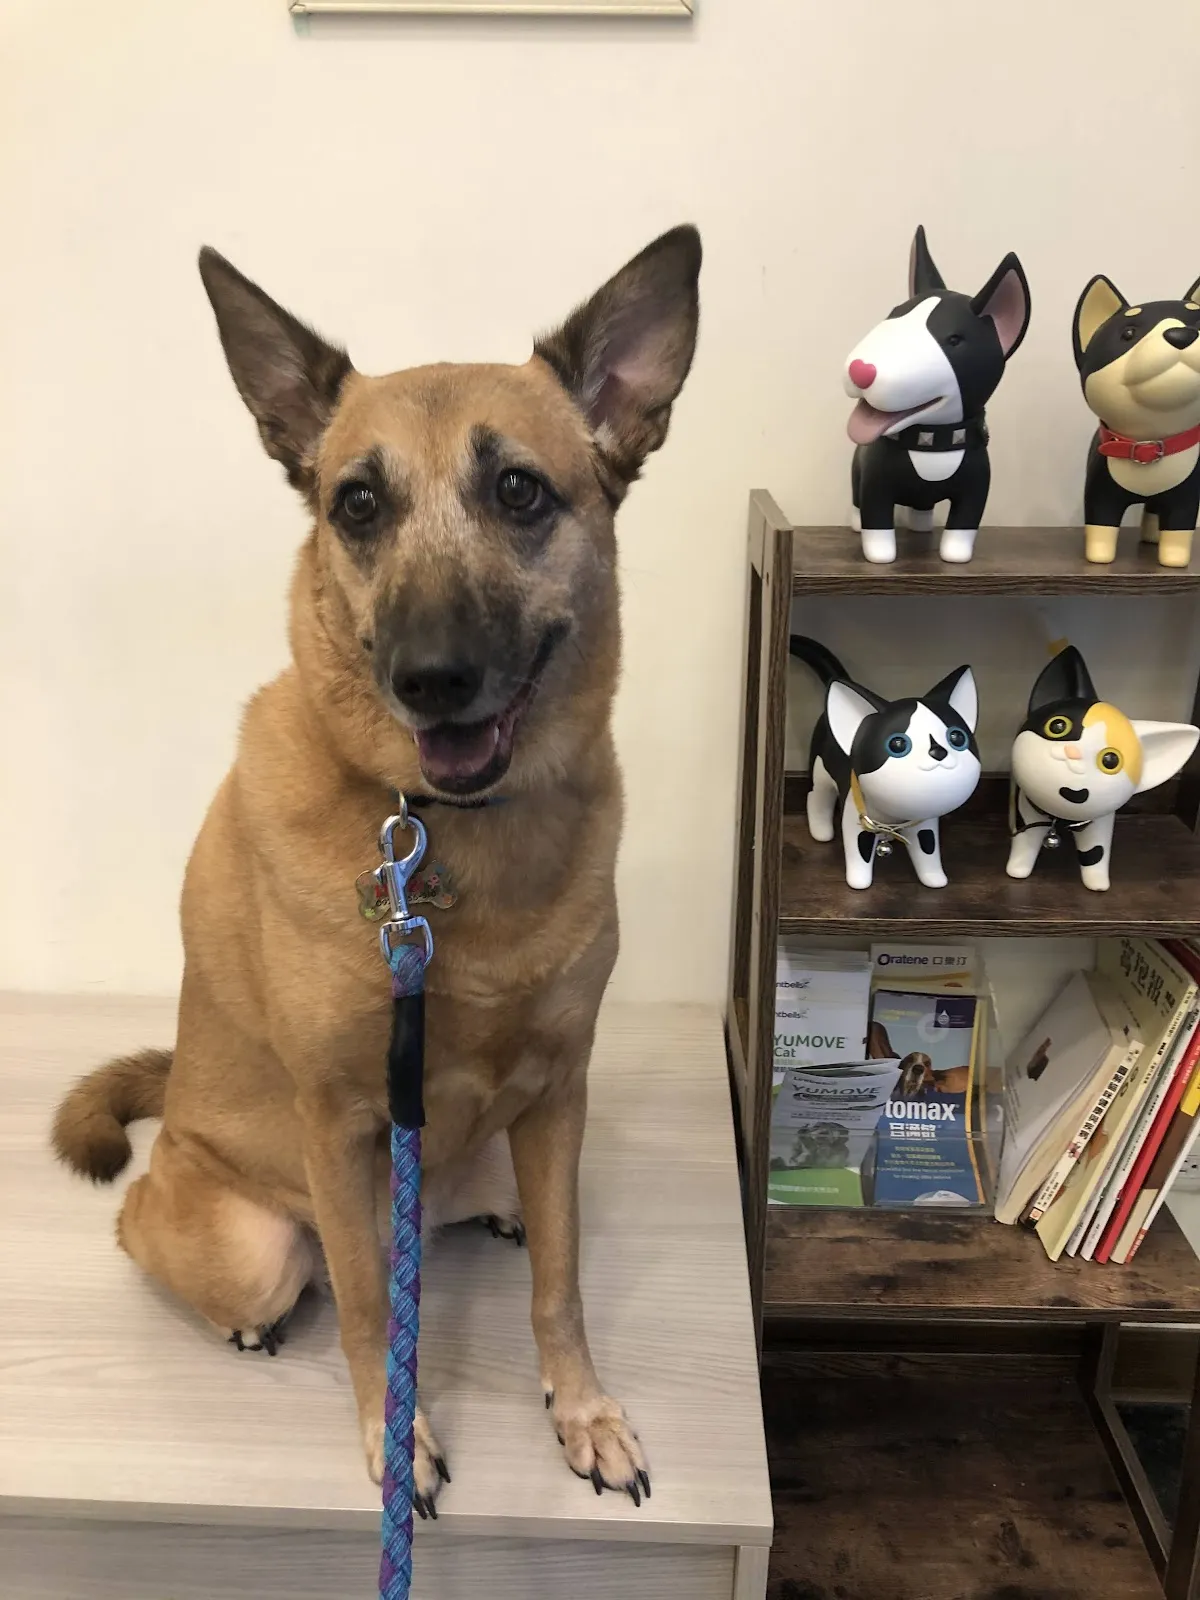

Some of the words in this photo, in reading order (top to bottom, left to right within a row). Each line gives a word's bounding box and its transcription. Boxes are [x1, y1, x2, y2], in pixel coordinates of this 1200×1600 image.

[877, 953, 929, 966] Oratene
[775, 981, 804, 989] ntbells
[774, 1047, 797, 1058] Cat
[885, 1099, 956, 1121] tomax
